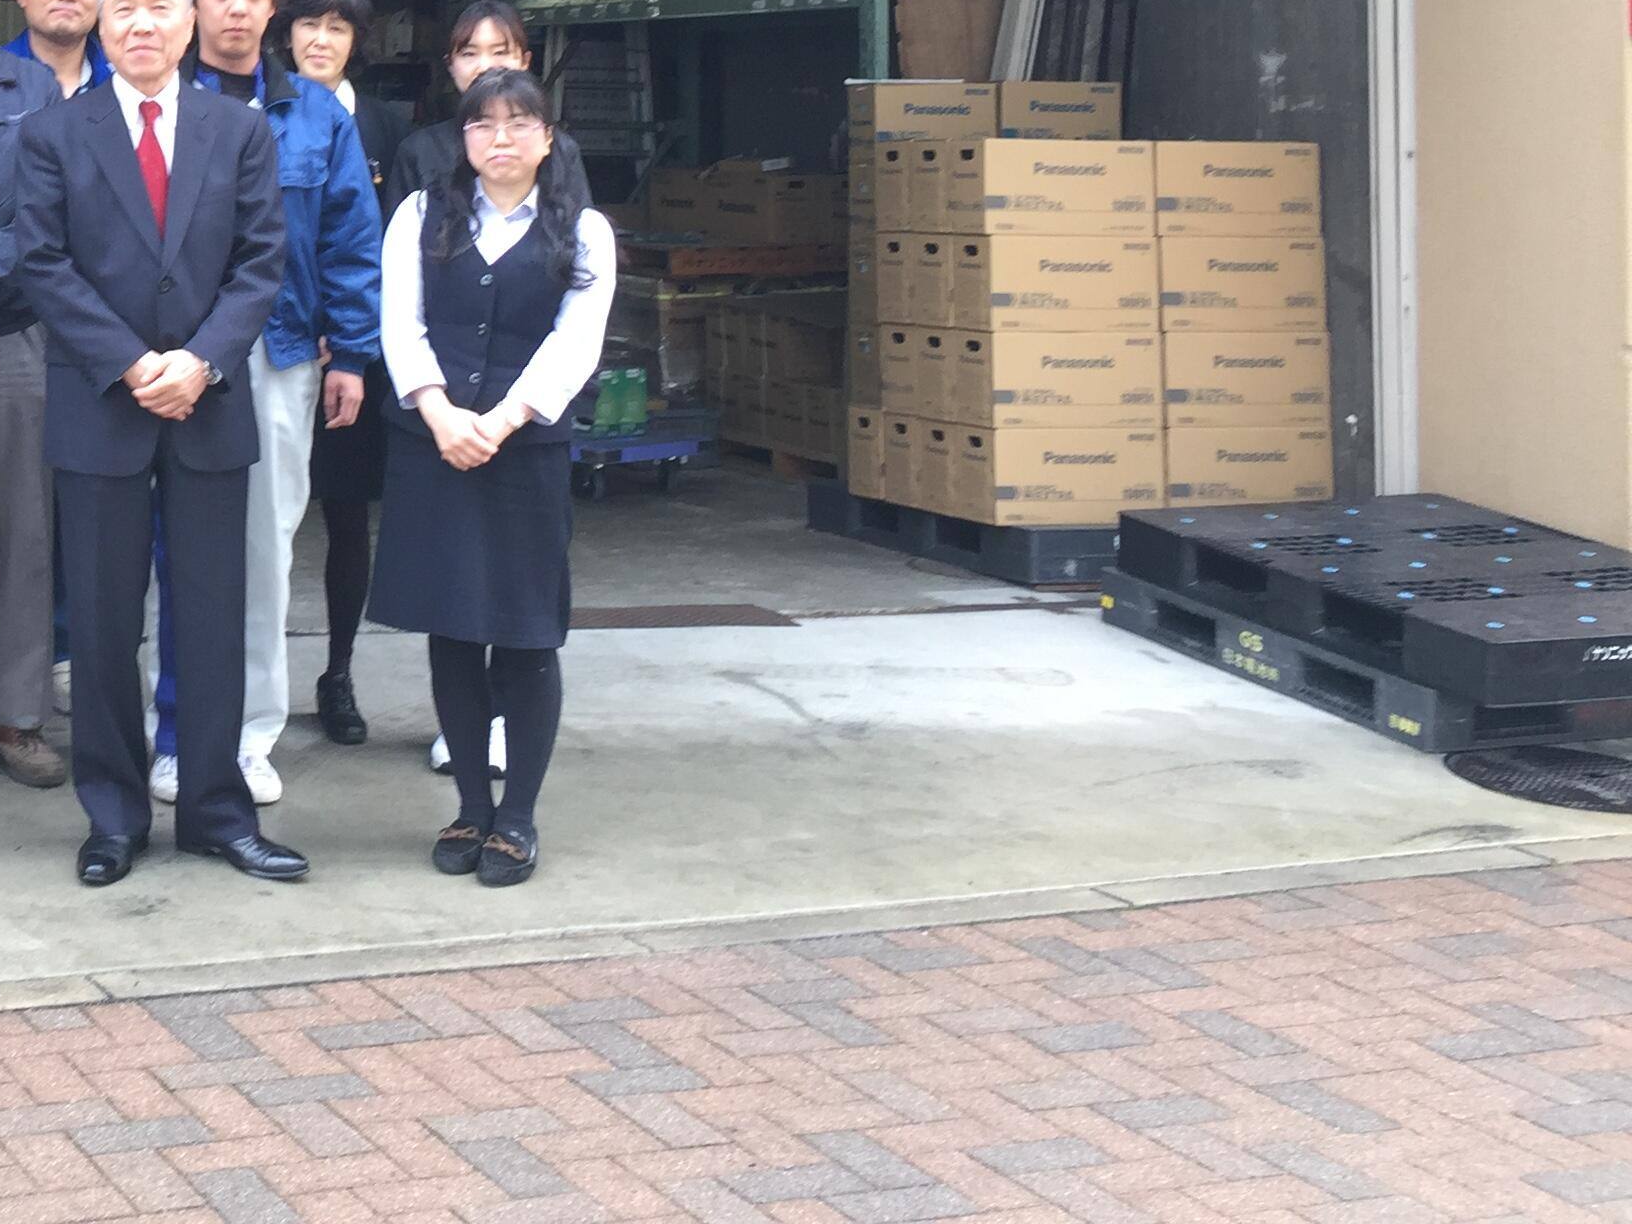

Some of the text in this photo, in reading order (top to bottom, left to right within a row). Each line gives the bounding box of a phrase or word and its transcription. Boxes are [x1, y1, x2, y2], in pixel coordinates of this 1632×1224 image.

[904, 103, 971, 116] Panasonic
[1030, 101, 1096, 113] Panasonic
[1033, 162, 1107, 176] Panasonic
[1204, 165, 1276, 178] Panasonic
[1039, 259, 1113, 273] Panasonic
[1208, 259, 1280, 272] Panasonic
[1042, 356, 1115, 369] Panasonic
[1214, 355, 1287, 368] Panasonic
[1044, 451, 1117, 465] Panasonic
[1217, 449, 1290, 463] Panasonic
